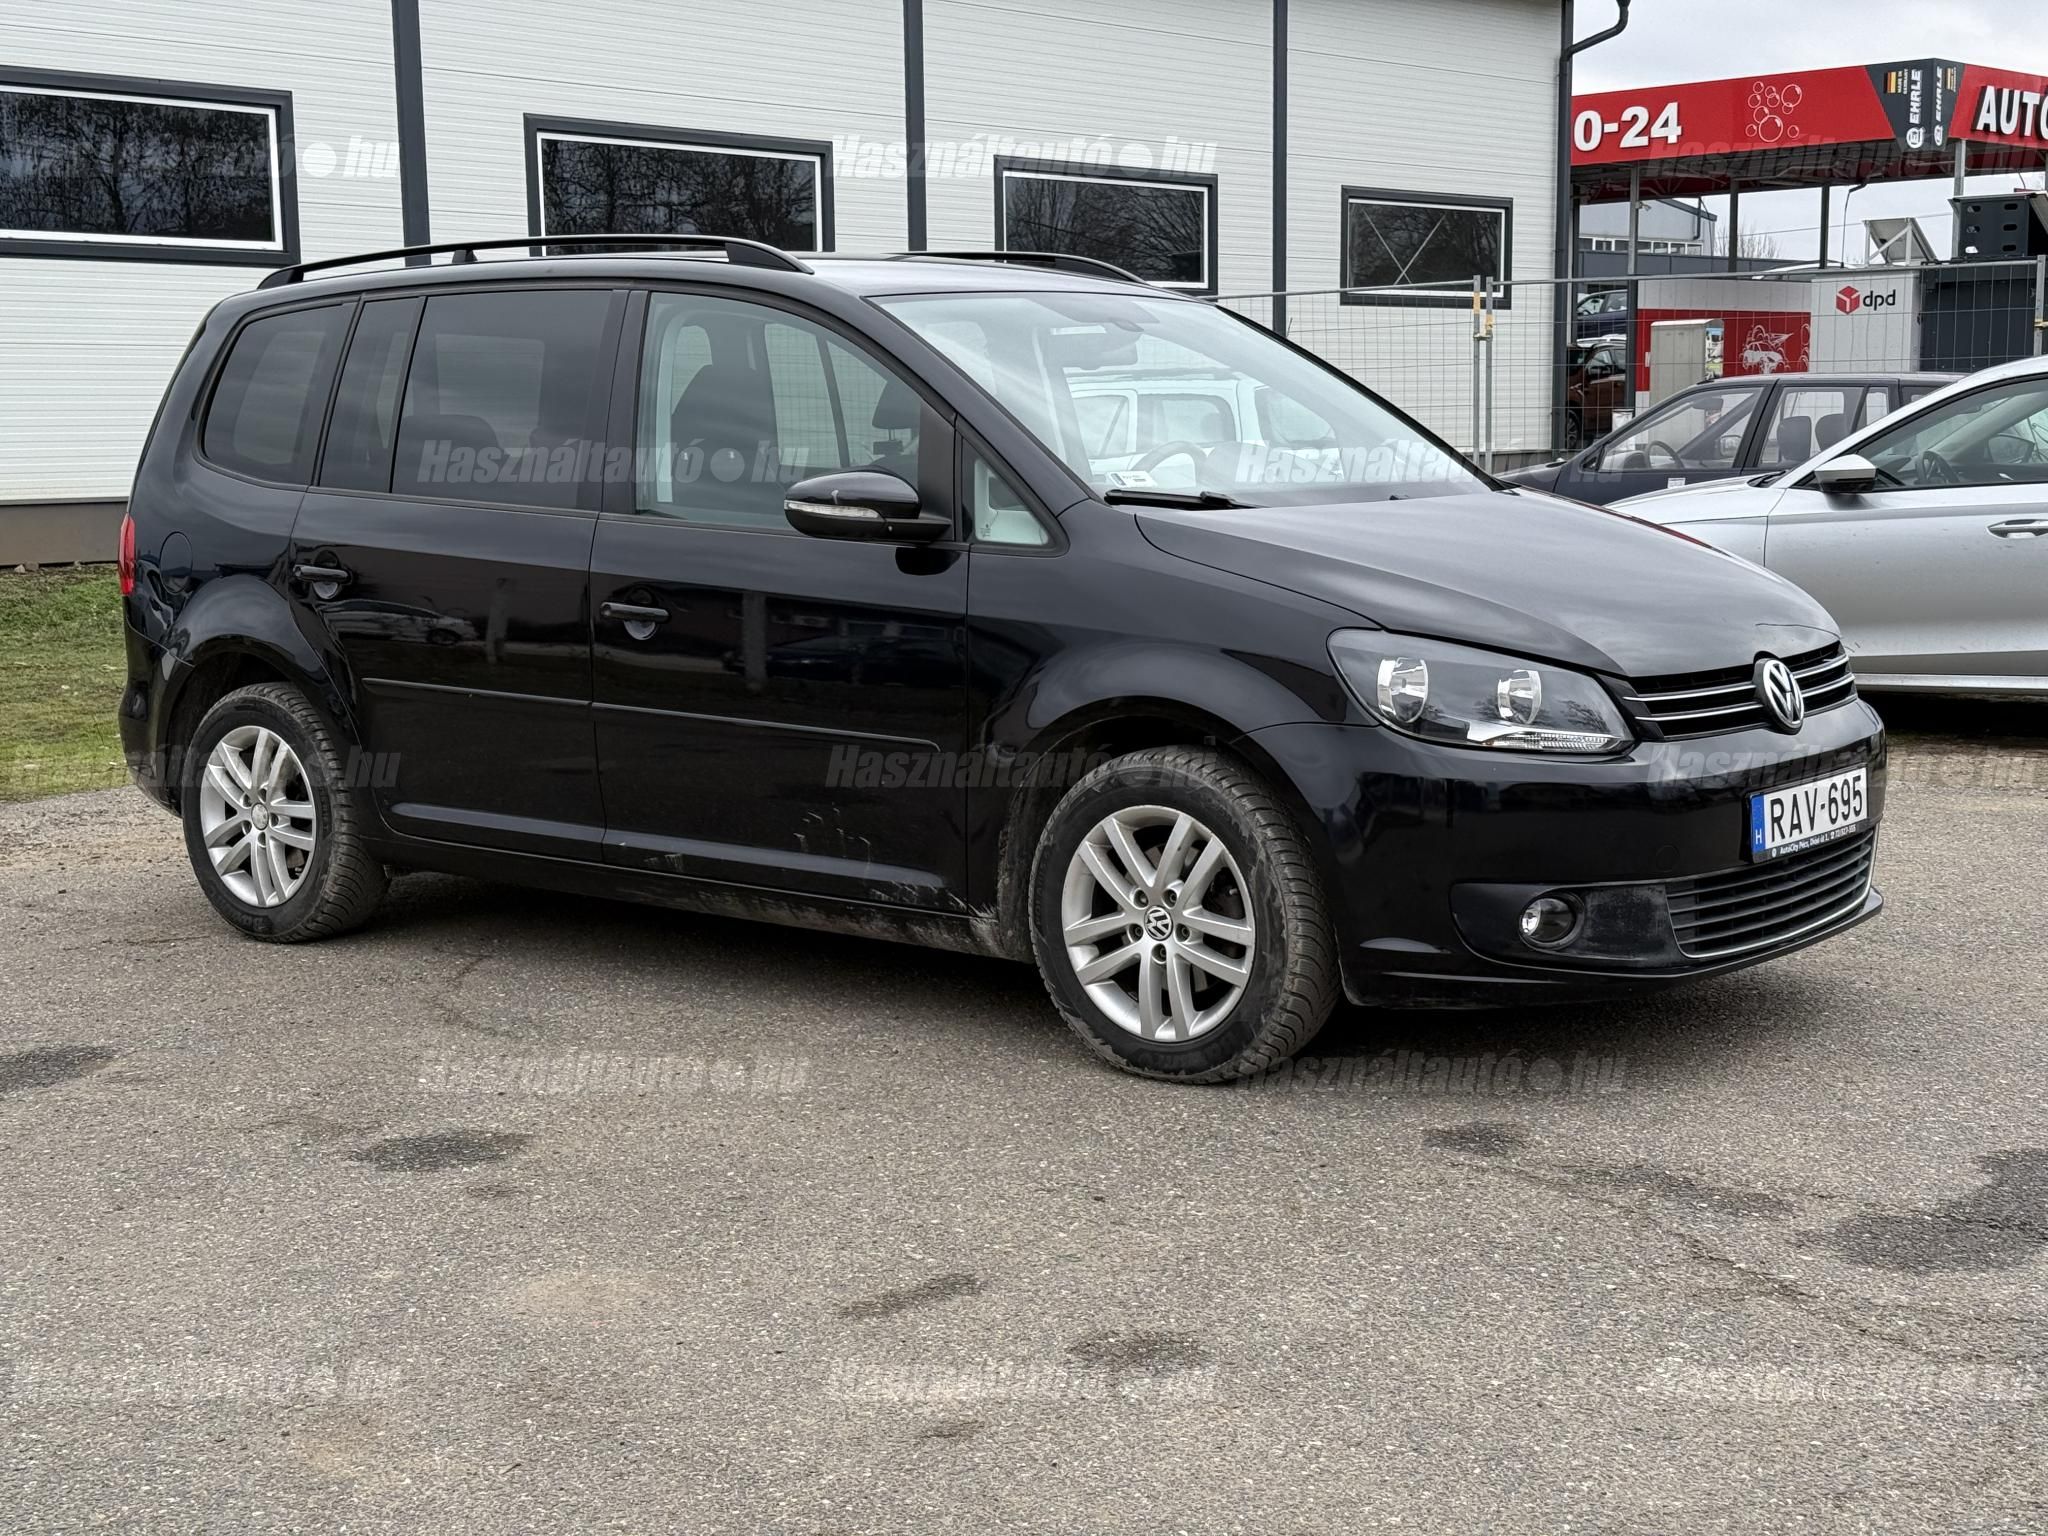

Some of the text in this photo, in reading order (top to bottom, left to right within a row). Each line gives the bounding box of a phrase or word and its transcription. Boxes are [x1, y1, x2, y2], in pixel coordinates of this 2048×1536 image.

[1909, 69, 1923, 124] EHRLE
[1574, 101, 1682, 151] 0-24
[1862, 289, 1896, 311] dpd
[1769, 774, 1863, 843] RAV-695
[1755, 829, 1763, 845] H
